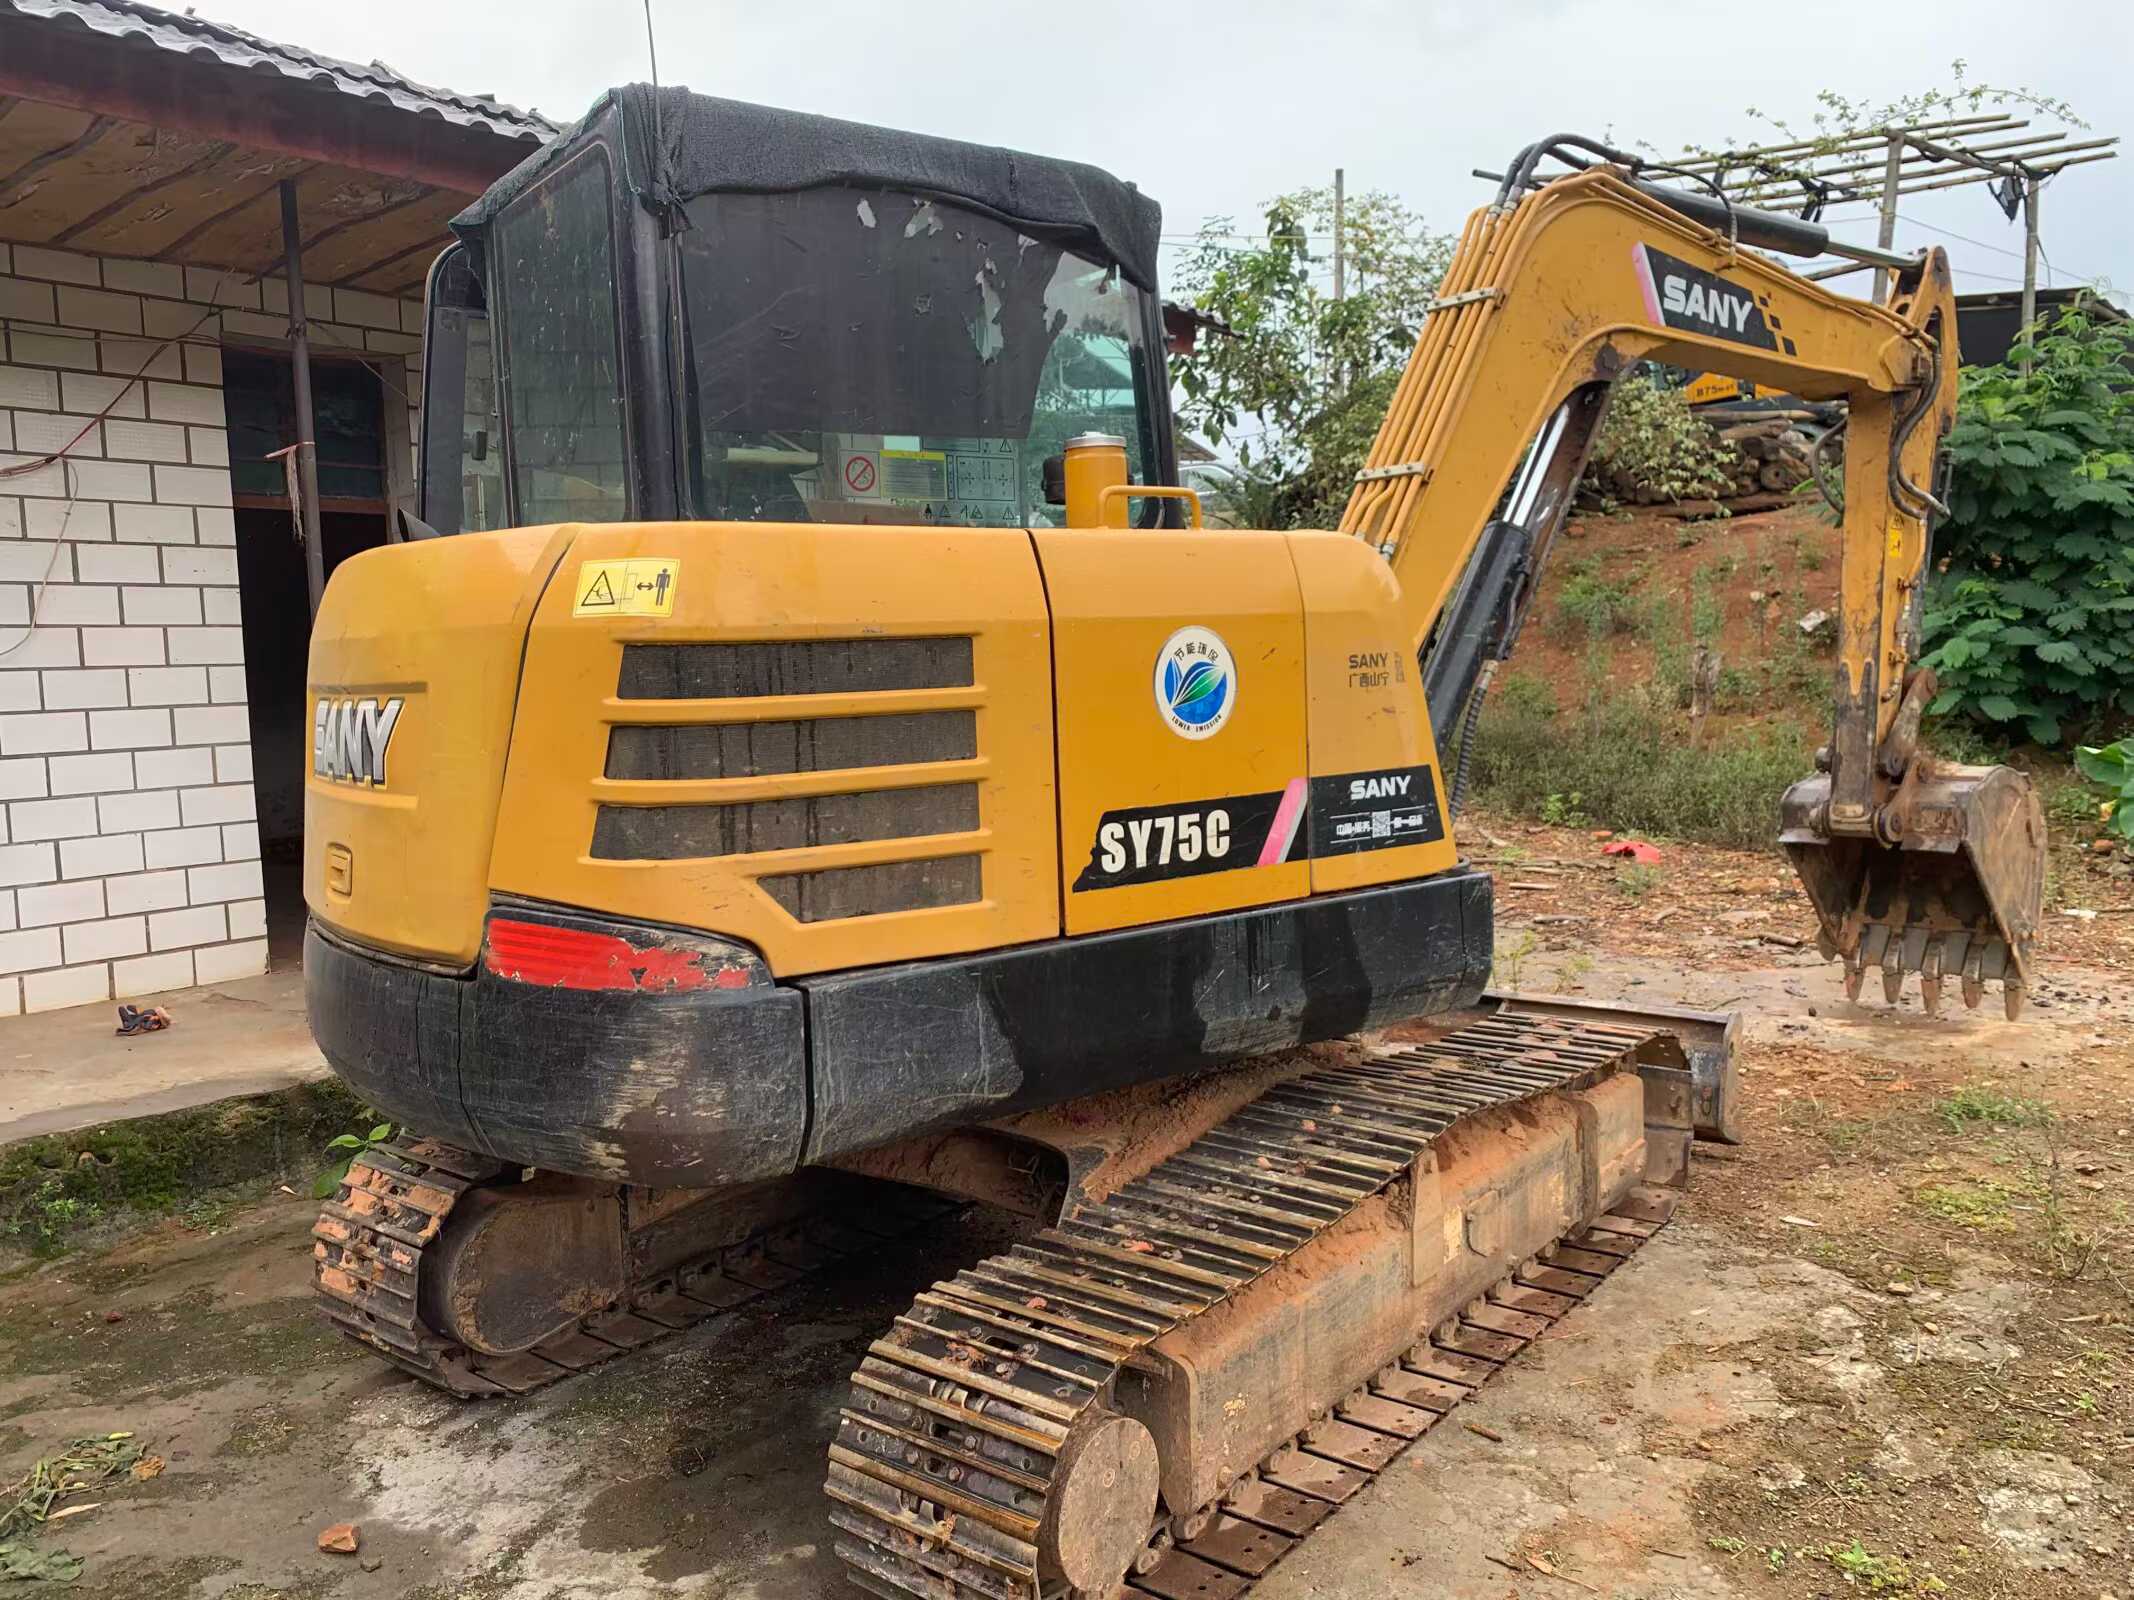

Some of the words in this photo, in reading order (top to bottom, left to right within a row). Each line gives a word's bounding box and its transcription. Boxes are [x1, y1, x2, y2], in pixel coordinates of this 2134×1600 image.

[1663, 274, 1754, 333] SANY
[1349, 652, 1388, 669] SANY
[314, 697, 404, 785] SANY
[1350, 775, 1411, 800] SANY
[1100, 809, 1231, 873] SY75C
